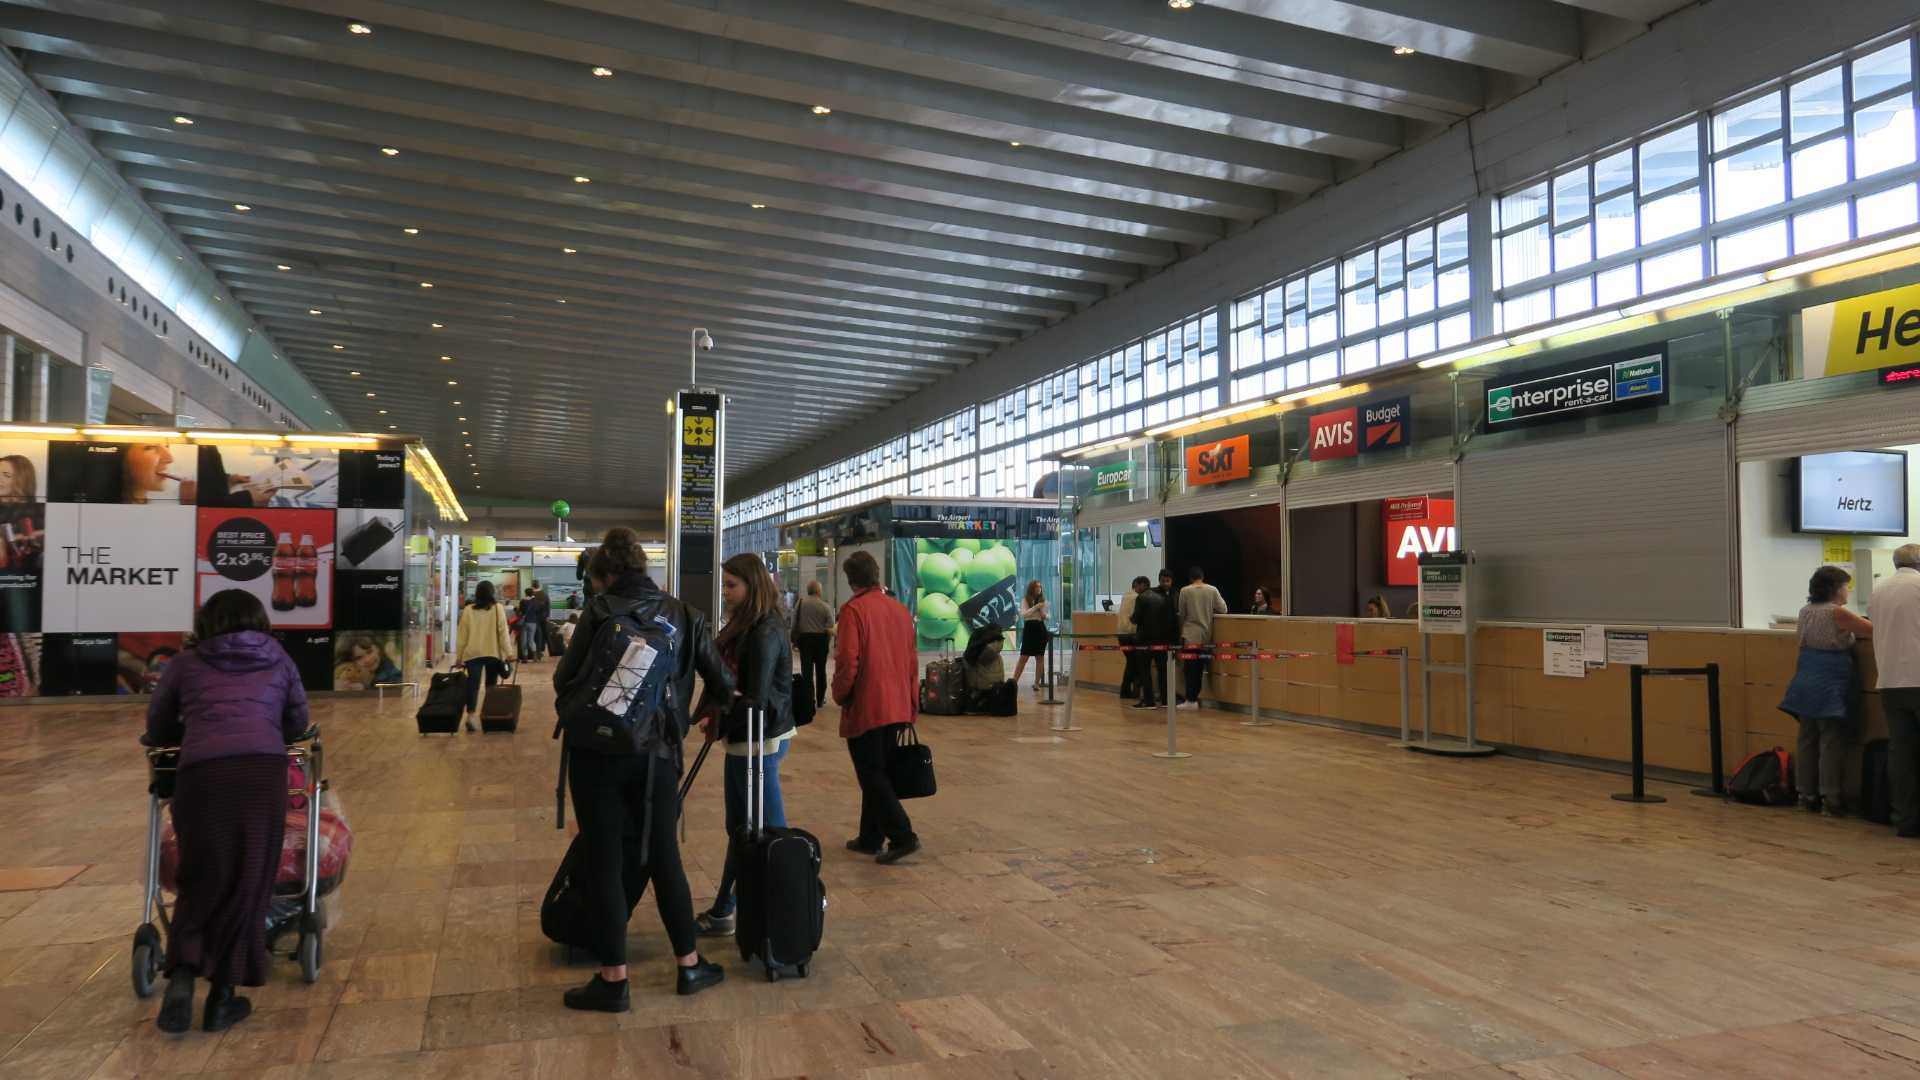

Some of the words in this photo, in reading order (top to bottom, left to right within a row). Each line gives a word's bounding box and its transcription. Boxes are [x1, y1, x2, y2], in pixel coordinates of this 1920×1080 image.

[1856, 306, 1920, 354] He
[1629, 366, 1654, 377] National
[1493, 378, 1609, 412] enterprise
[1565, 392, 1609, 407] rent-a-car
[1366, 404, 1401, 422] Budget
[1314, 421, 1353, 449] AVIS
[1097, 469, 1132, 487] Europcar
[1837, 496, 1873, 511] Hertz
[947, 520, 997, 530] MARKET
[61, 546, 112, 565] THE
[66, 567, 180, 585] MARKET
